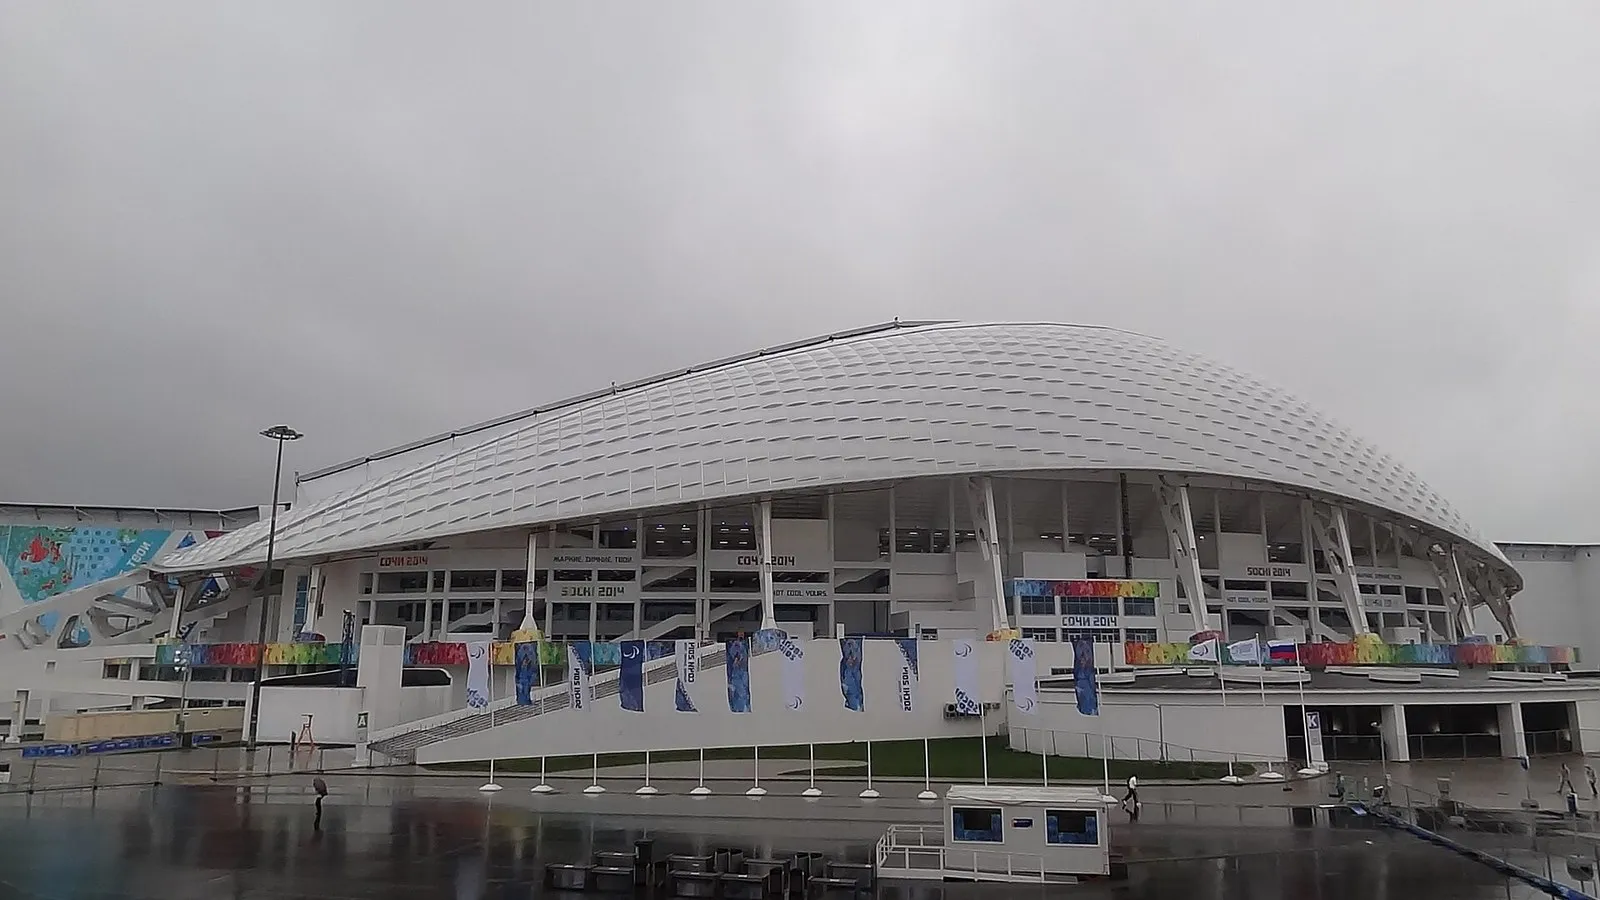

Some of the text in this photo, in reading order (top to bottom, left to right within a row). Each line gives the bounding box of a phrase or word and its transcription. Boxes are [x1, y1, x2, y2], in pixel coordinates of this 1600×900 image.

[380, 556, 428, 567] СОЧИ 2014
[737, 555, 795, 566] СОЧ 2014
[1247, 567, 1291, 577] SOCHI 2014
[598, 586, 625, 597] 2014
[1062, 616, 1118, 627] СОЧИ 2014
[358, 715, 366, 726] A
[1307, 715, 1317, 727] K
